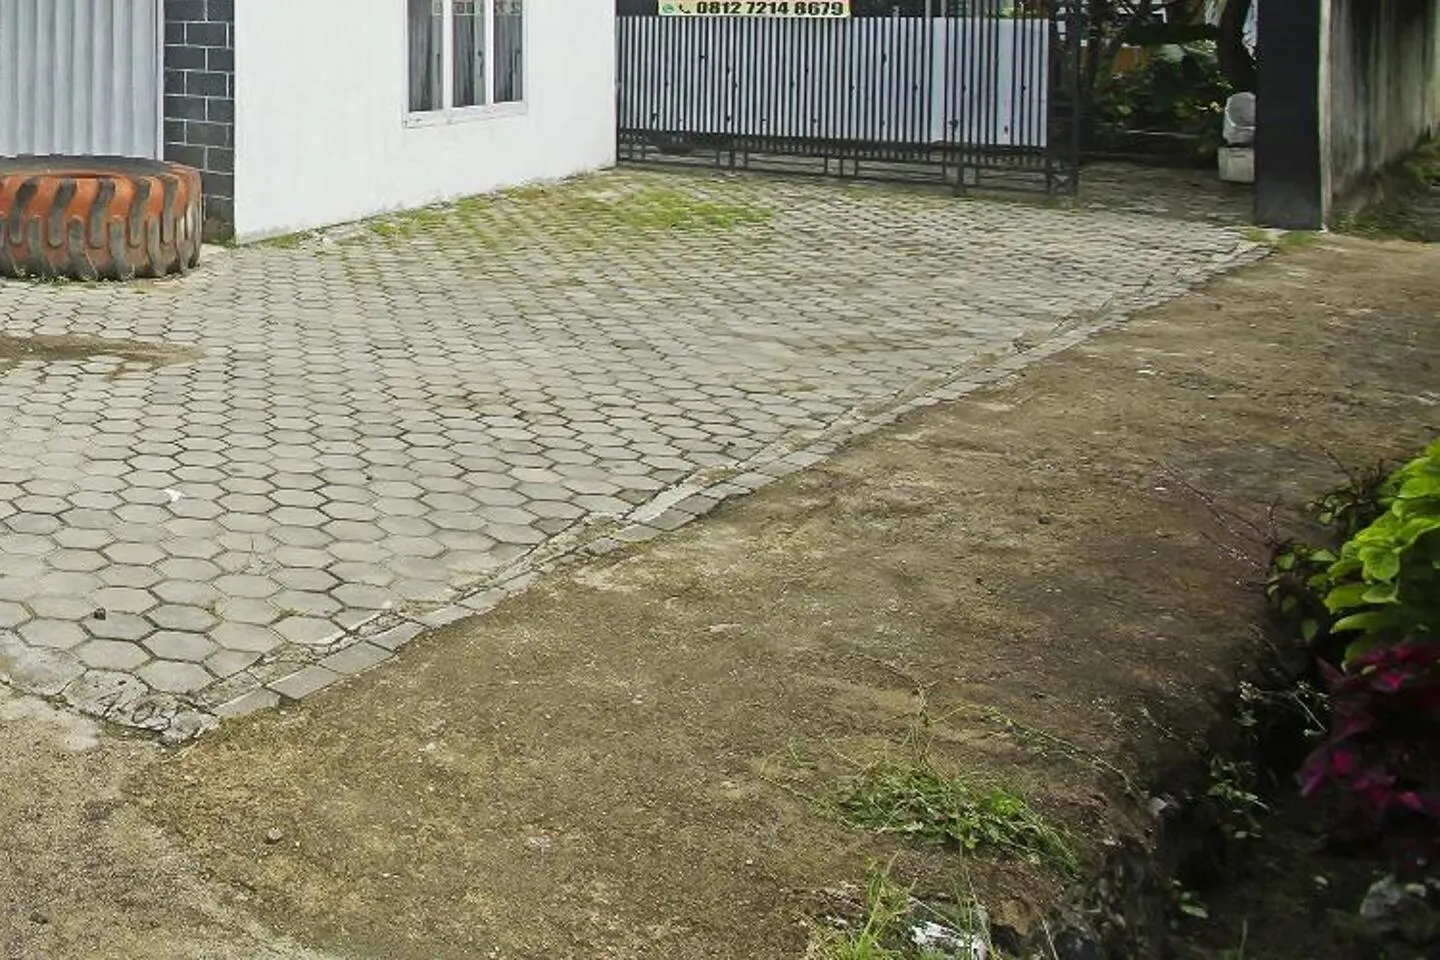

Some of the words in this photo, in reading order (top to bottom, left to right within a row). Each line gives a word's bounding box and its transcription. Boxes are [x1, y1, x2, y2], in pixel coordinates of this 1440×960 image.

[696, 1, 741, 14] 0812
[746, 1, 788, 14] 7214
[794, 1, 844, 15] 8679
